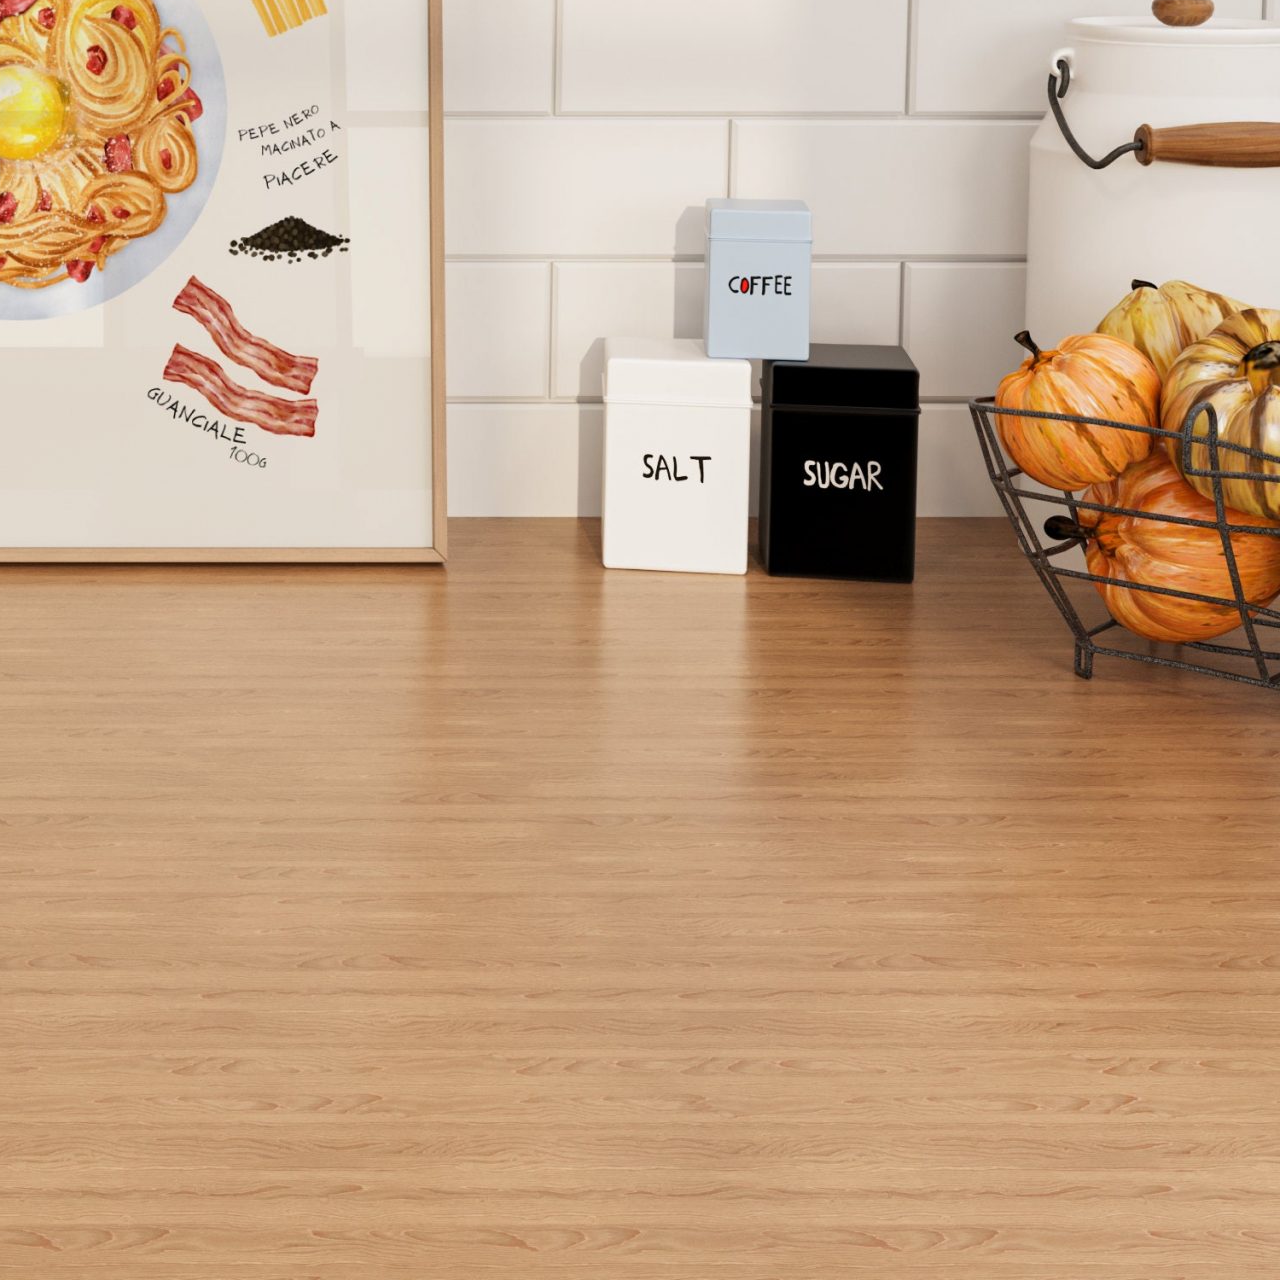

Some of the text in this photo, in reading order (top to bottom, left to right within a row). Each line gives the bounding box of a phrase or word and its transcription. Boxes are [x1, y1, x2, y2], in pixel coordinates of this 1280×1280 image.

[238, 105, 319, 141] PEPE NERO
[261, 120, 341, 156] MACINATO A
[263, 149, 338, 190] PIACERE
[728, 274, 792, 295] COFFEE
[147, 388, 246, 444] GUANCIALE
[230, 446, 267, 468] 100G
[642, 454, 712, 483] SALT
[803, 460, 883, 491] SUGAR
